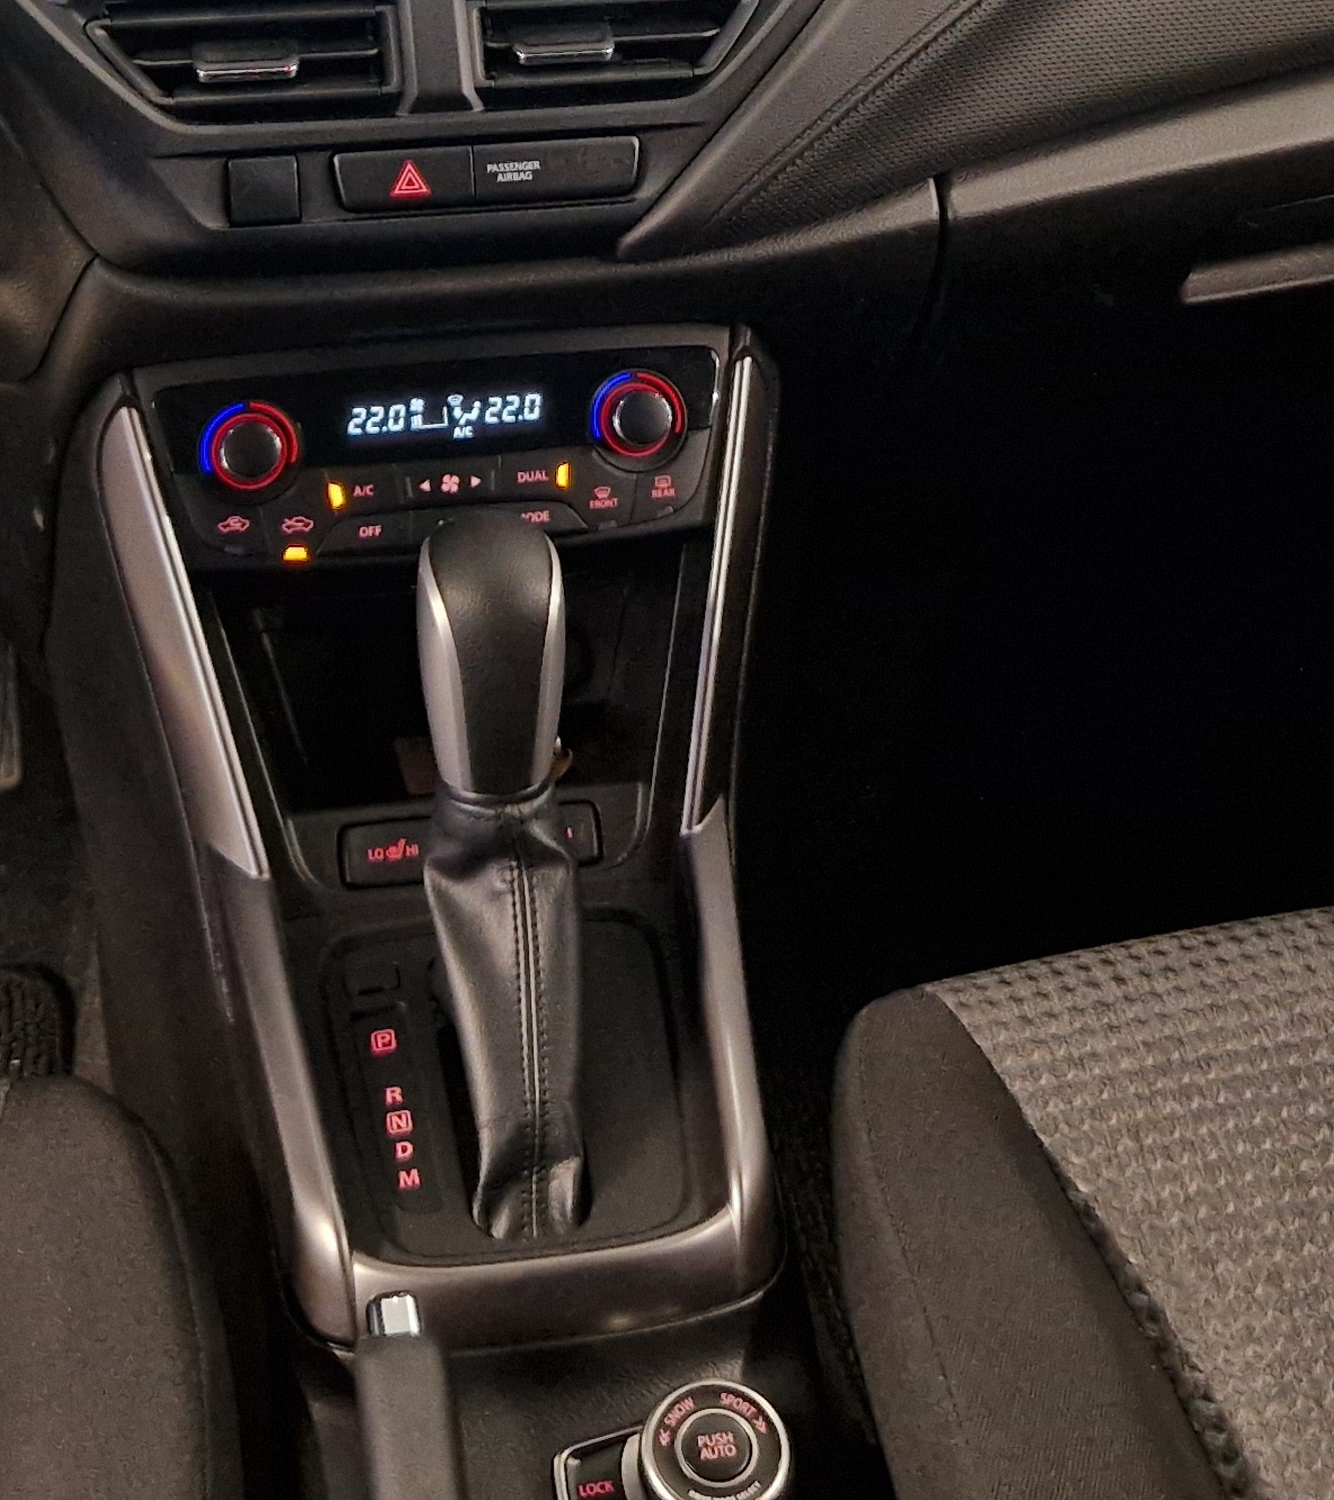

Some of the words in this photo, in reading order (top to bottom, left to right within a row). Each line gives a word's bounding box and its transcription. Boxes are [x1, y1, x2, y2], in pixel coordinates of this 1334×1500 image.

[487, 160, 540, 173] PASSENGER
[497, 171, 533, 182] AIRBAG
[485, 393, 542, 424] 22.0
[347, 404, 406, 435] 22.0
[517, 470, 549, 483] DUAL
[353, 484, 374, 497] A/C
[651, 489, 676, 498] REAR
[589, 499, 618, 509] FRONT
[359, 525, 382, 537] OFF
[367, 848, 383, 861] LO
[406, 844, 419, 856] HI
[385, 1086, 404, 1105] R
[395, 1141, 413, 1160] D
[399, 1168, 421, 1189] M
[664, 1397, 694, 1428] SNOW
[721, 1393, 758, 1417] SPORT
[697, 1432, 734, 1448] PUSH
[700, 1444, 736, 1460] AUTO
[579, 1481, 615, 1498] LOCK
